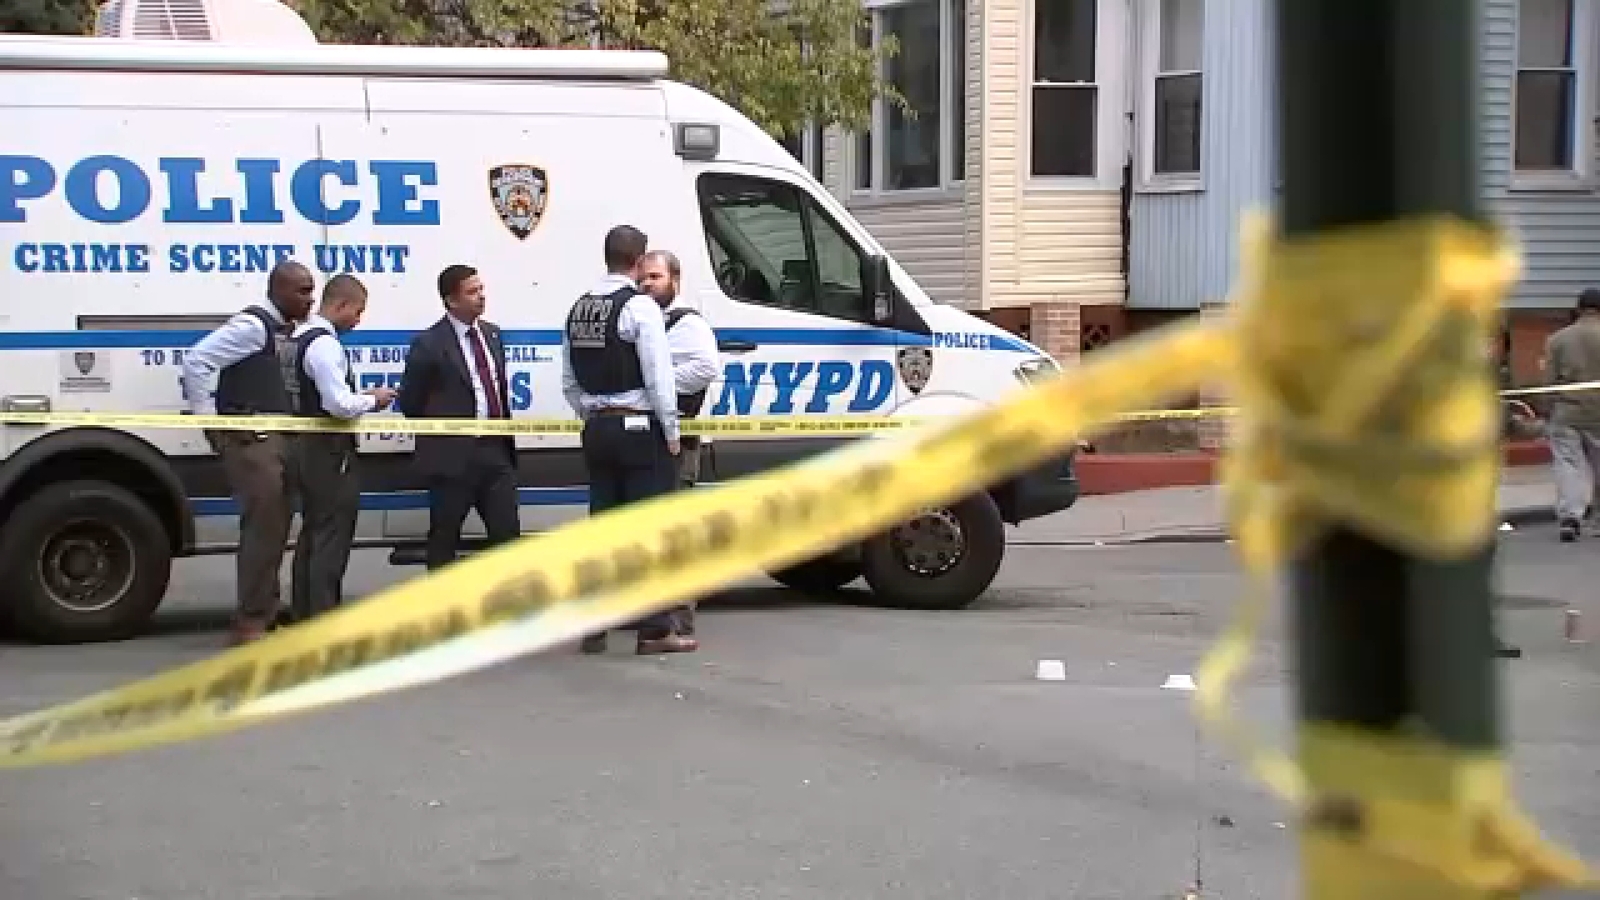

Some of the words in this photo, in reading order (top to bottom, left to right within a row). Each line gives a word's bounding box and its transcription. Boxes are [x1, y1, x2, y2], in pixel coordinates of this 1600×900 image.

[0, 154, 441, 226] POLICE
[14, 242, 150, 274] CRIME
[168, 243, 295, 274] SCENE
[312, 244, 410, 274] UNIT
[932, 332, 991, 350] POLICE
[140, 349, 167, 366] TO
[710, 359, 895, 416] NYPD
